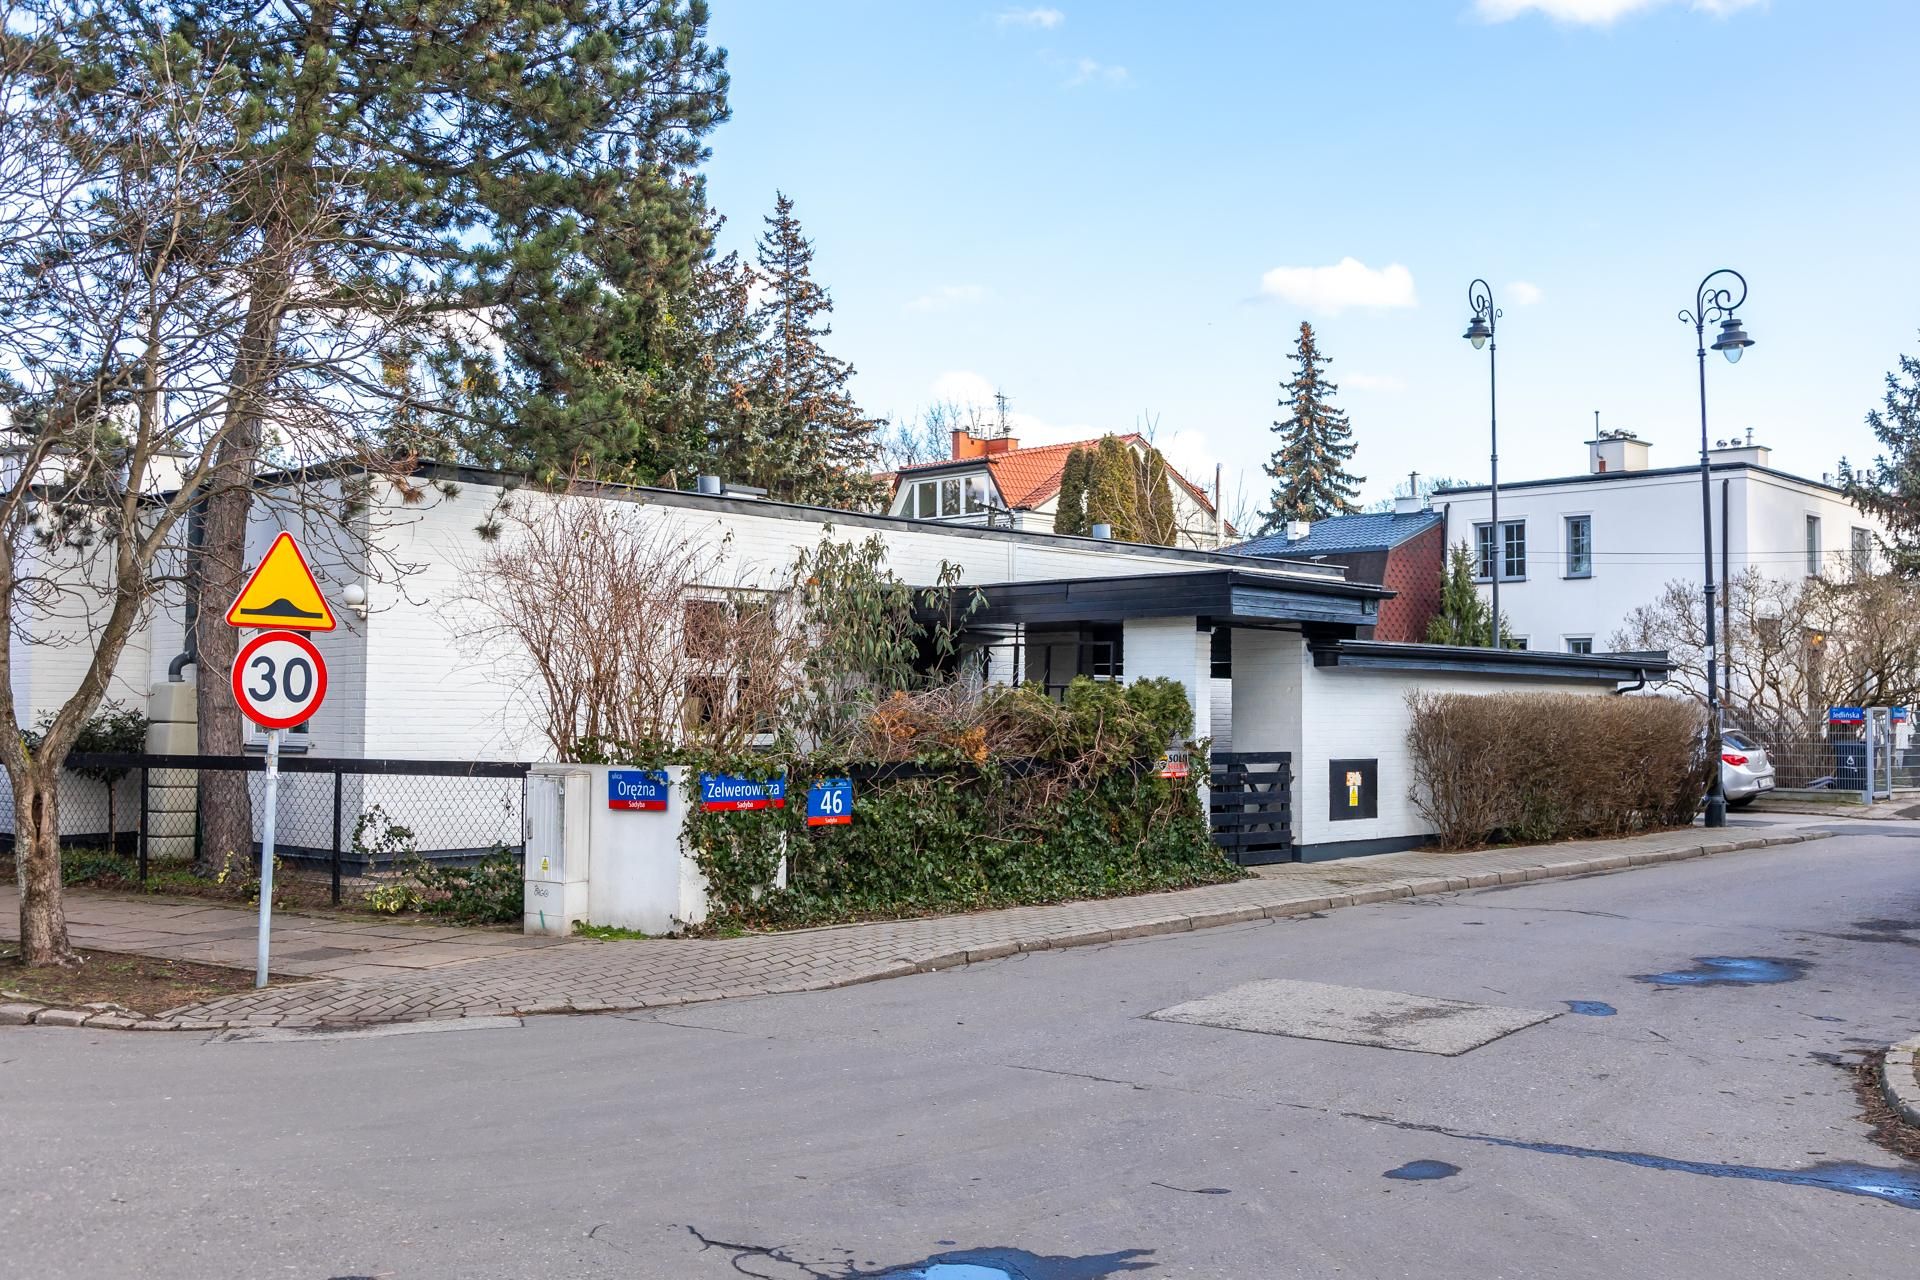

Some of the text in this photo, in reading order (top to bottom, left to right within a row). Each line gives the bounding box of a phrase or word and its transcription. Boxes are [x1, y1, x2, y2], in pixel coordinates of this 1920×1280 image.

[248, 656, 313, 703] 30
[618, 781, 655, 800] Orężna
[707, 781, 780, 798] Zelwerowiza
[628, 800, 646, 809] Sadyba
[736, 801, 754, 809] Sadyba
[820, 789, 843, 814] 46
